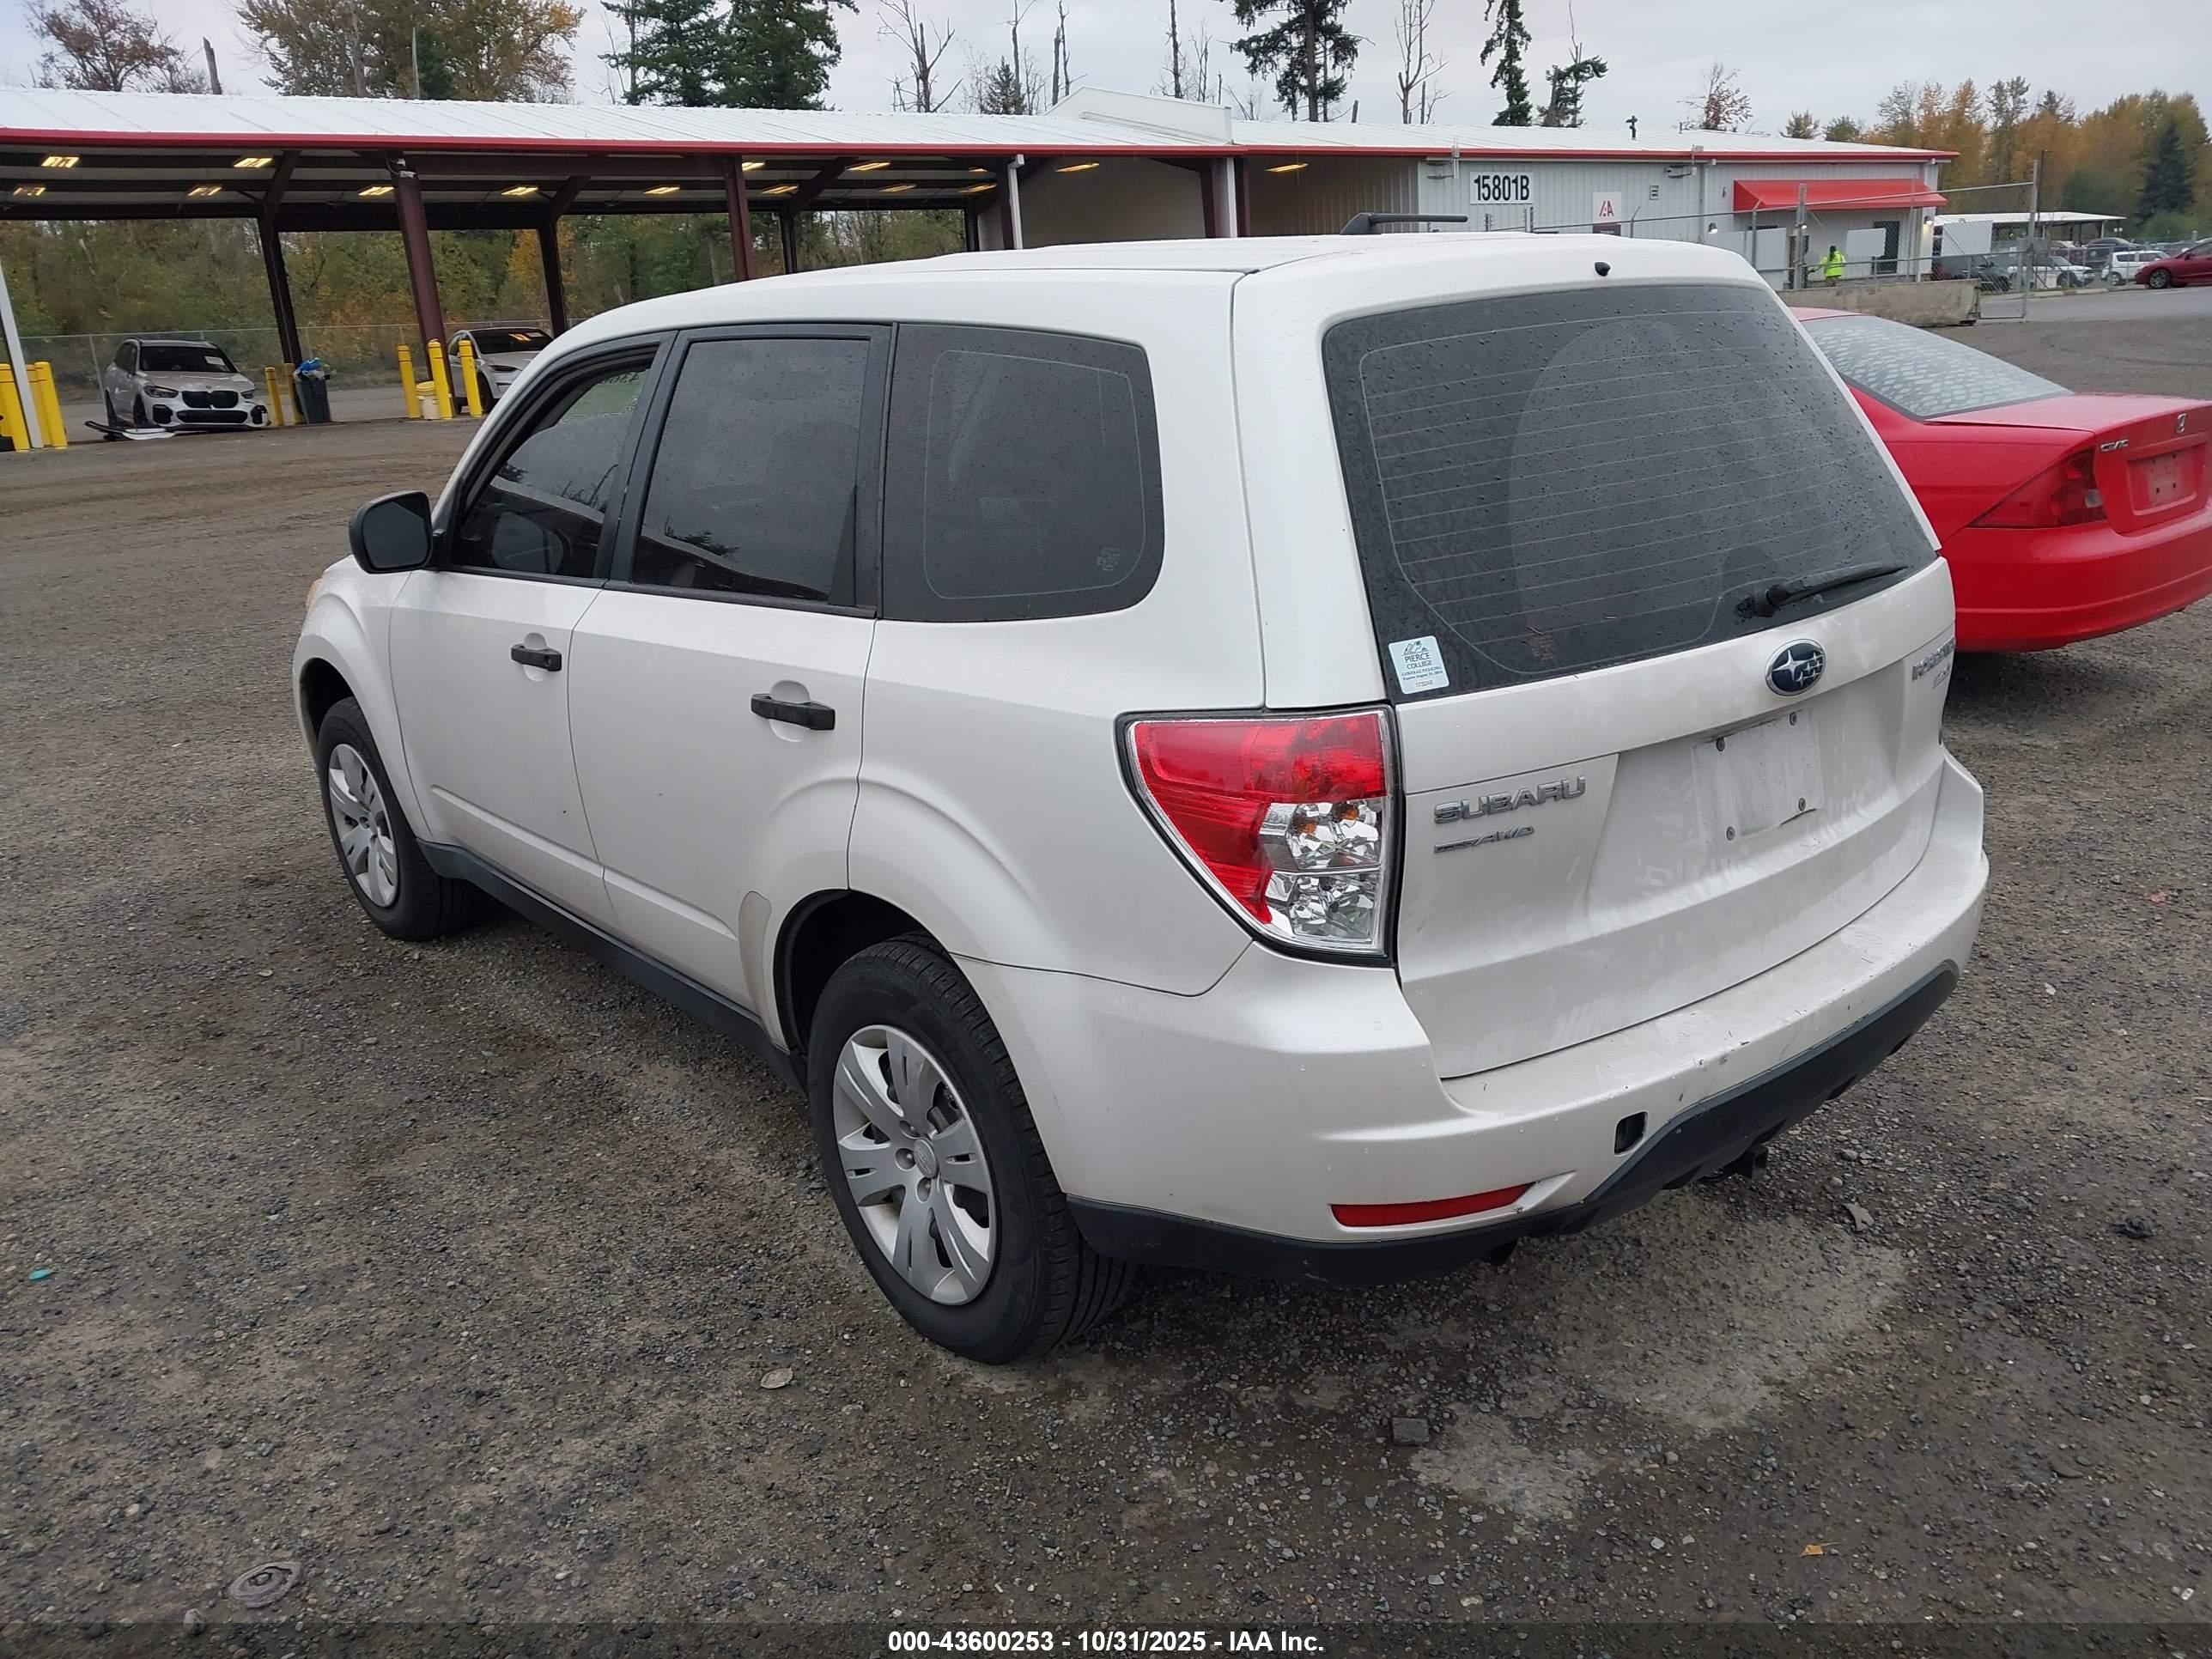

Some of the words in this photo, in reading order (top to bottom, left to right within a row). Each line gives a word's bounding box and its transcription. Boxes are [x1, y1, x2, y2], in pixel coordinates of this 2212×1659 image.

[1474, 174, 1530, 201] 15801B
[1405, 653, 1431, 663] PIERCE
[1407, 660, 1433, 669] COLLEGE
[1433, 776, 1586, 824] SUBARU
